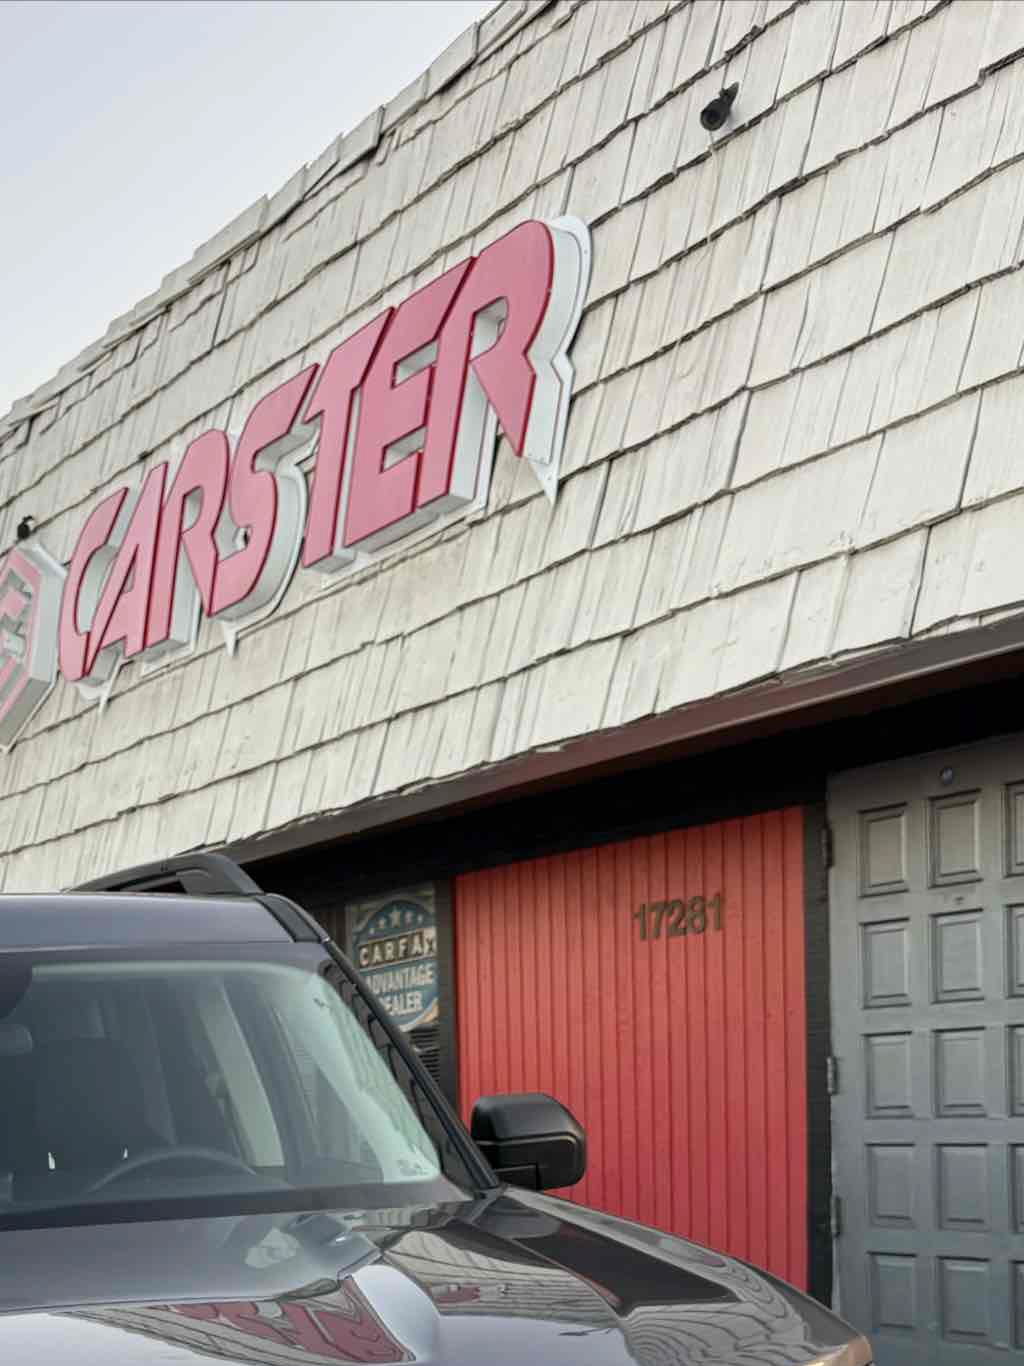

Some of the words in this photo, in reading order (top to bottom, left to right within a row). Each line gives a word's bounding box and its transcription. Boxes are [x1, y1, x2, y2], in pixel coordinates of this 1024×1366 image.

[58, 218, 566, 683] CARSTER
[633, 893, 722, 941] 17281
[377, 990, 423, 1016] EALER
